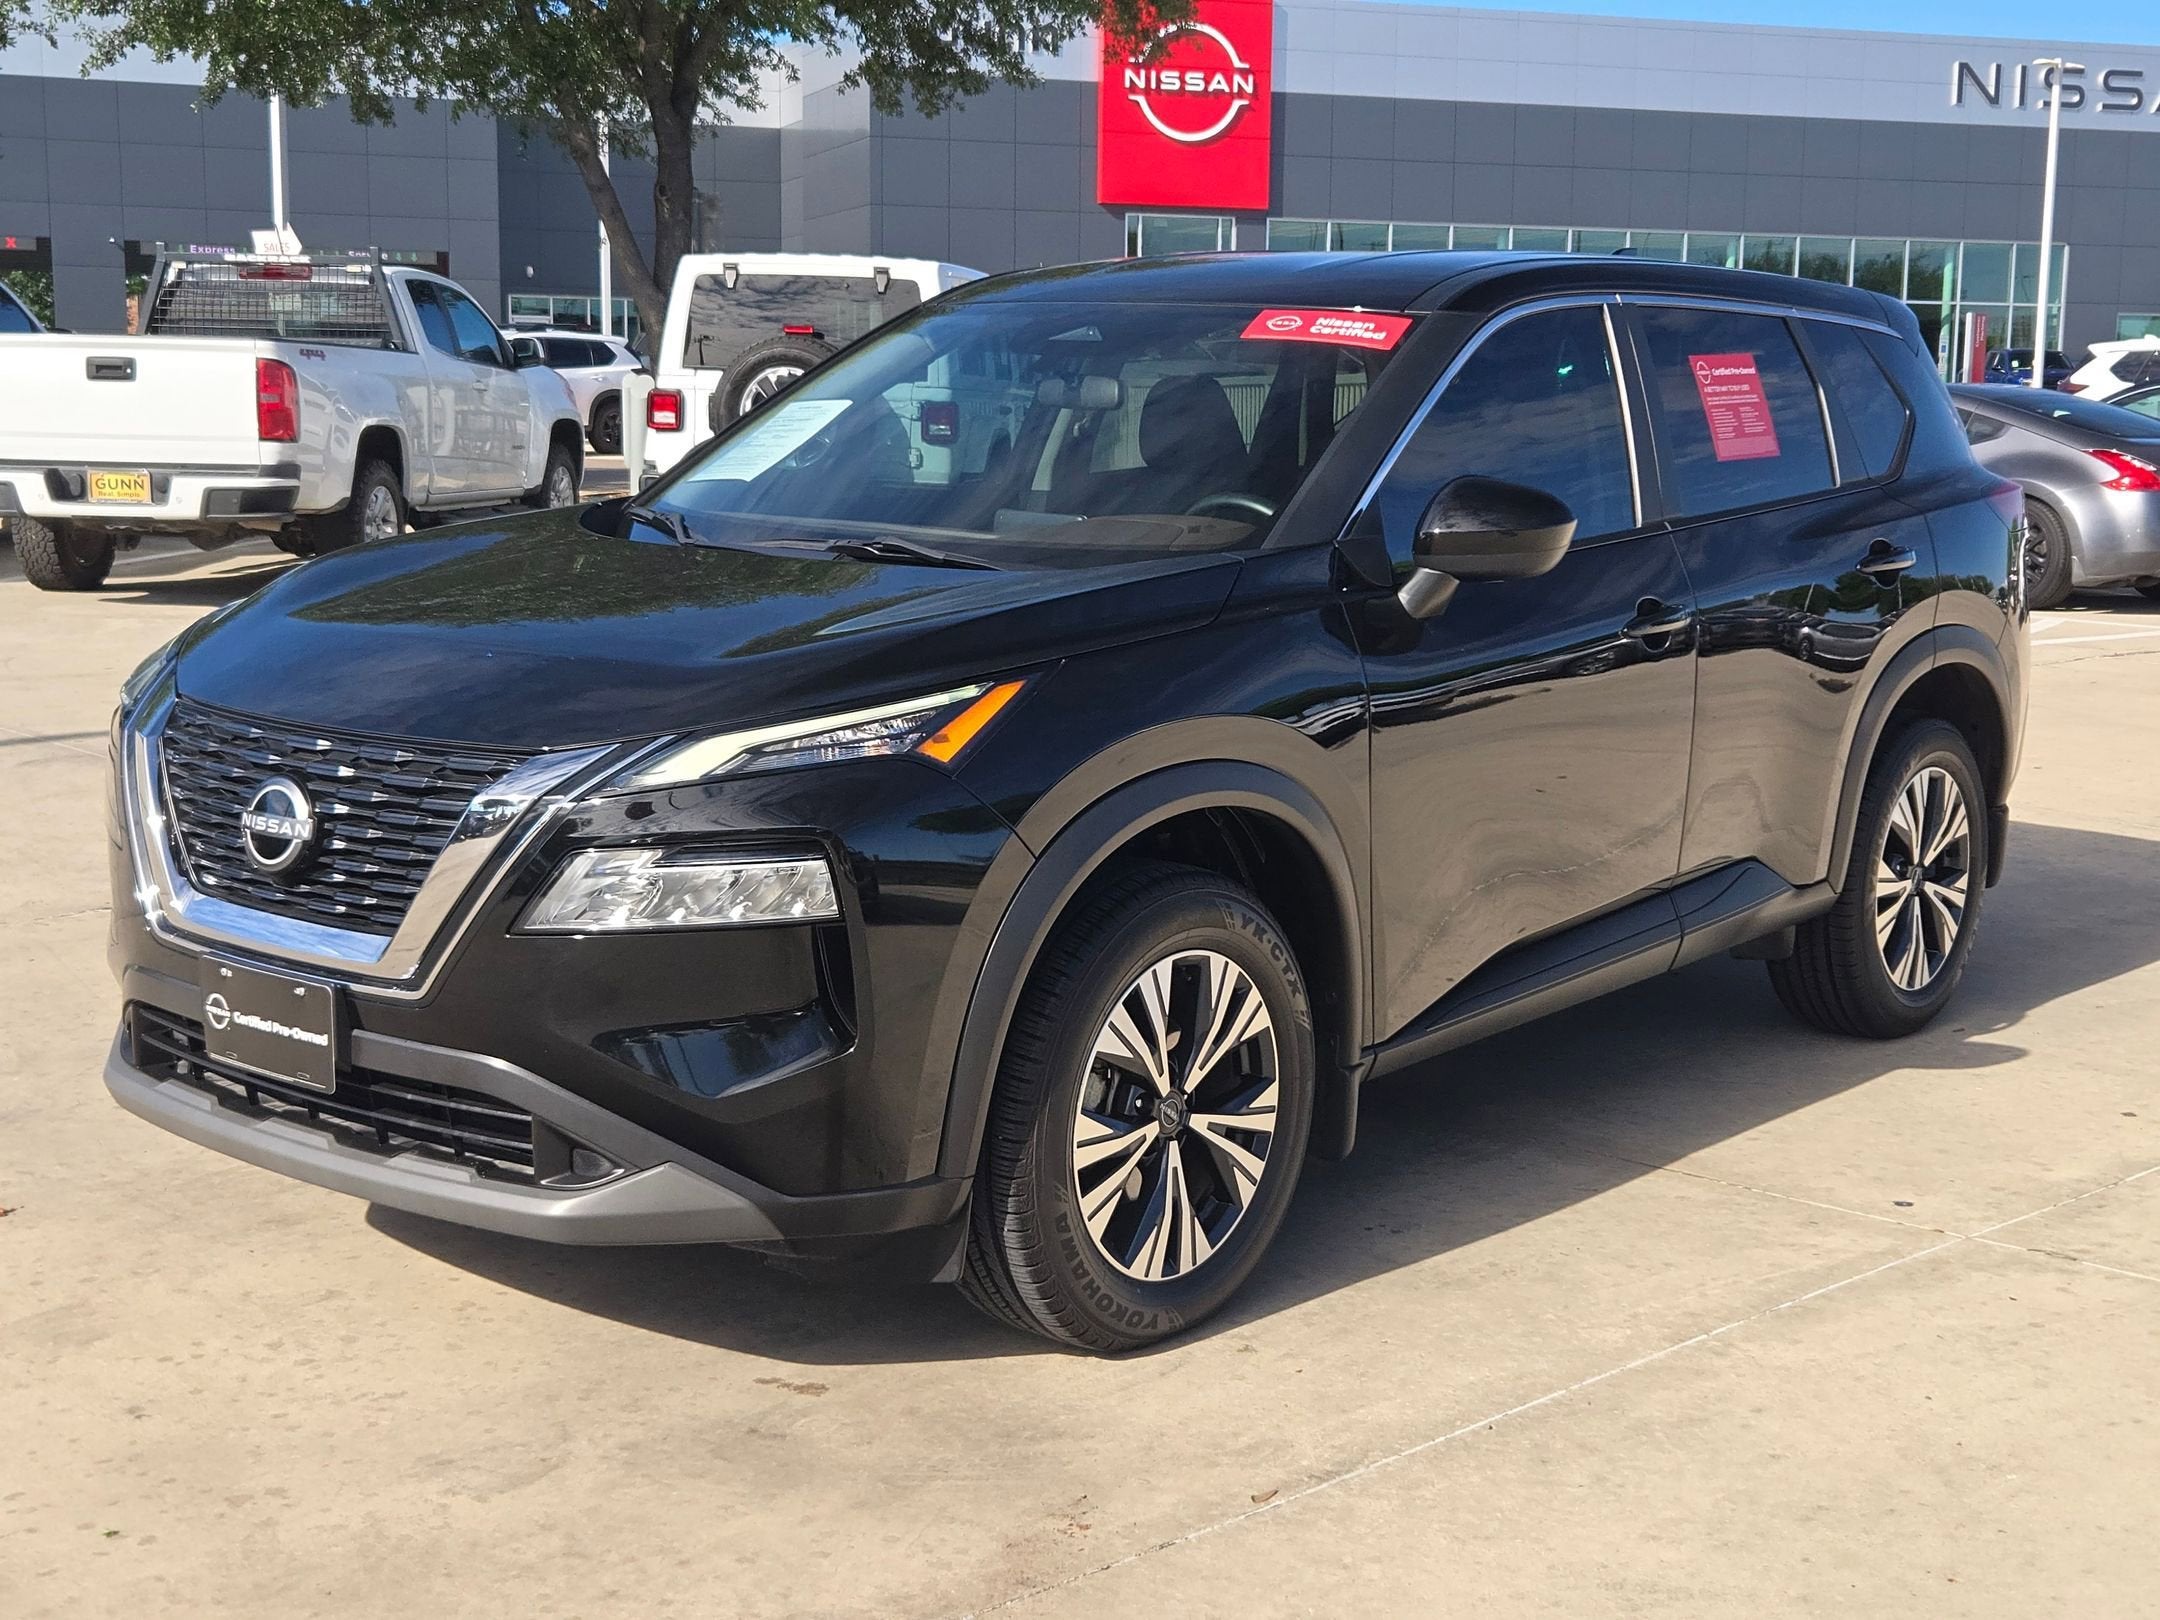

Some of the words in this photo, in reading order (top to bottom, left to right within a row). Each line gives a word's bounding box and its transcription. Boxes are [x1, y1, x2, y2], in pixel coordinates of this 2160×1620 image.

[1124, 68, 1254, 94] NISSAN
[1309, 325, 1387, 341] Certified
[1315, 317, 1375, 330] Nissan
[95, 478, 145, 490] GUNN
[242, 812, 310, 838] NISSAN
[232, 1011, 272, 1032] Certified
[272, 1021, 329, 1047] Pre-Owned
[1055, 1212, 1160, 1330] YOKOHAMA
